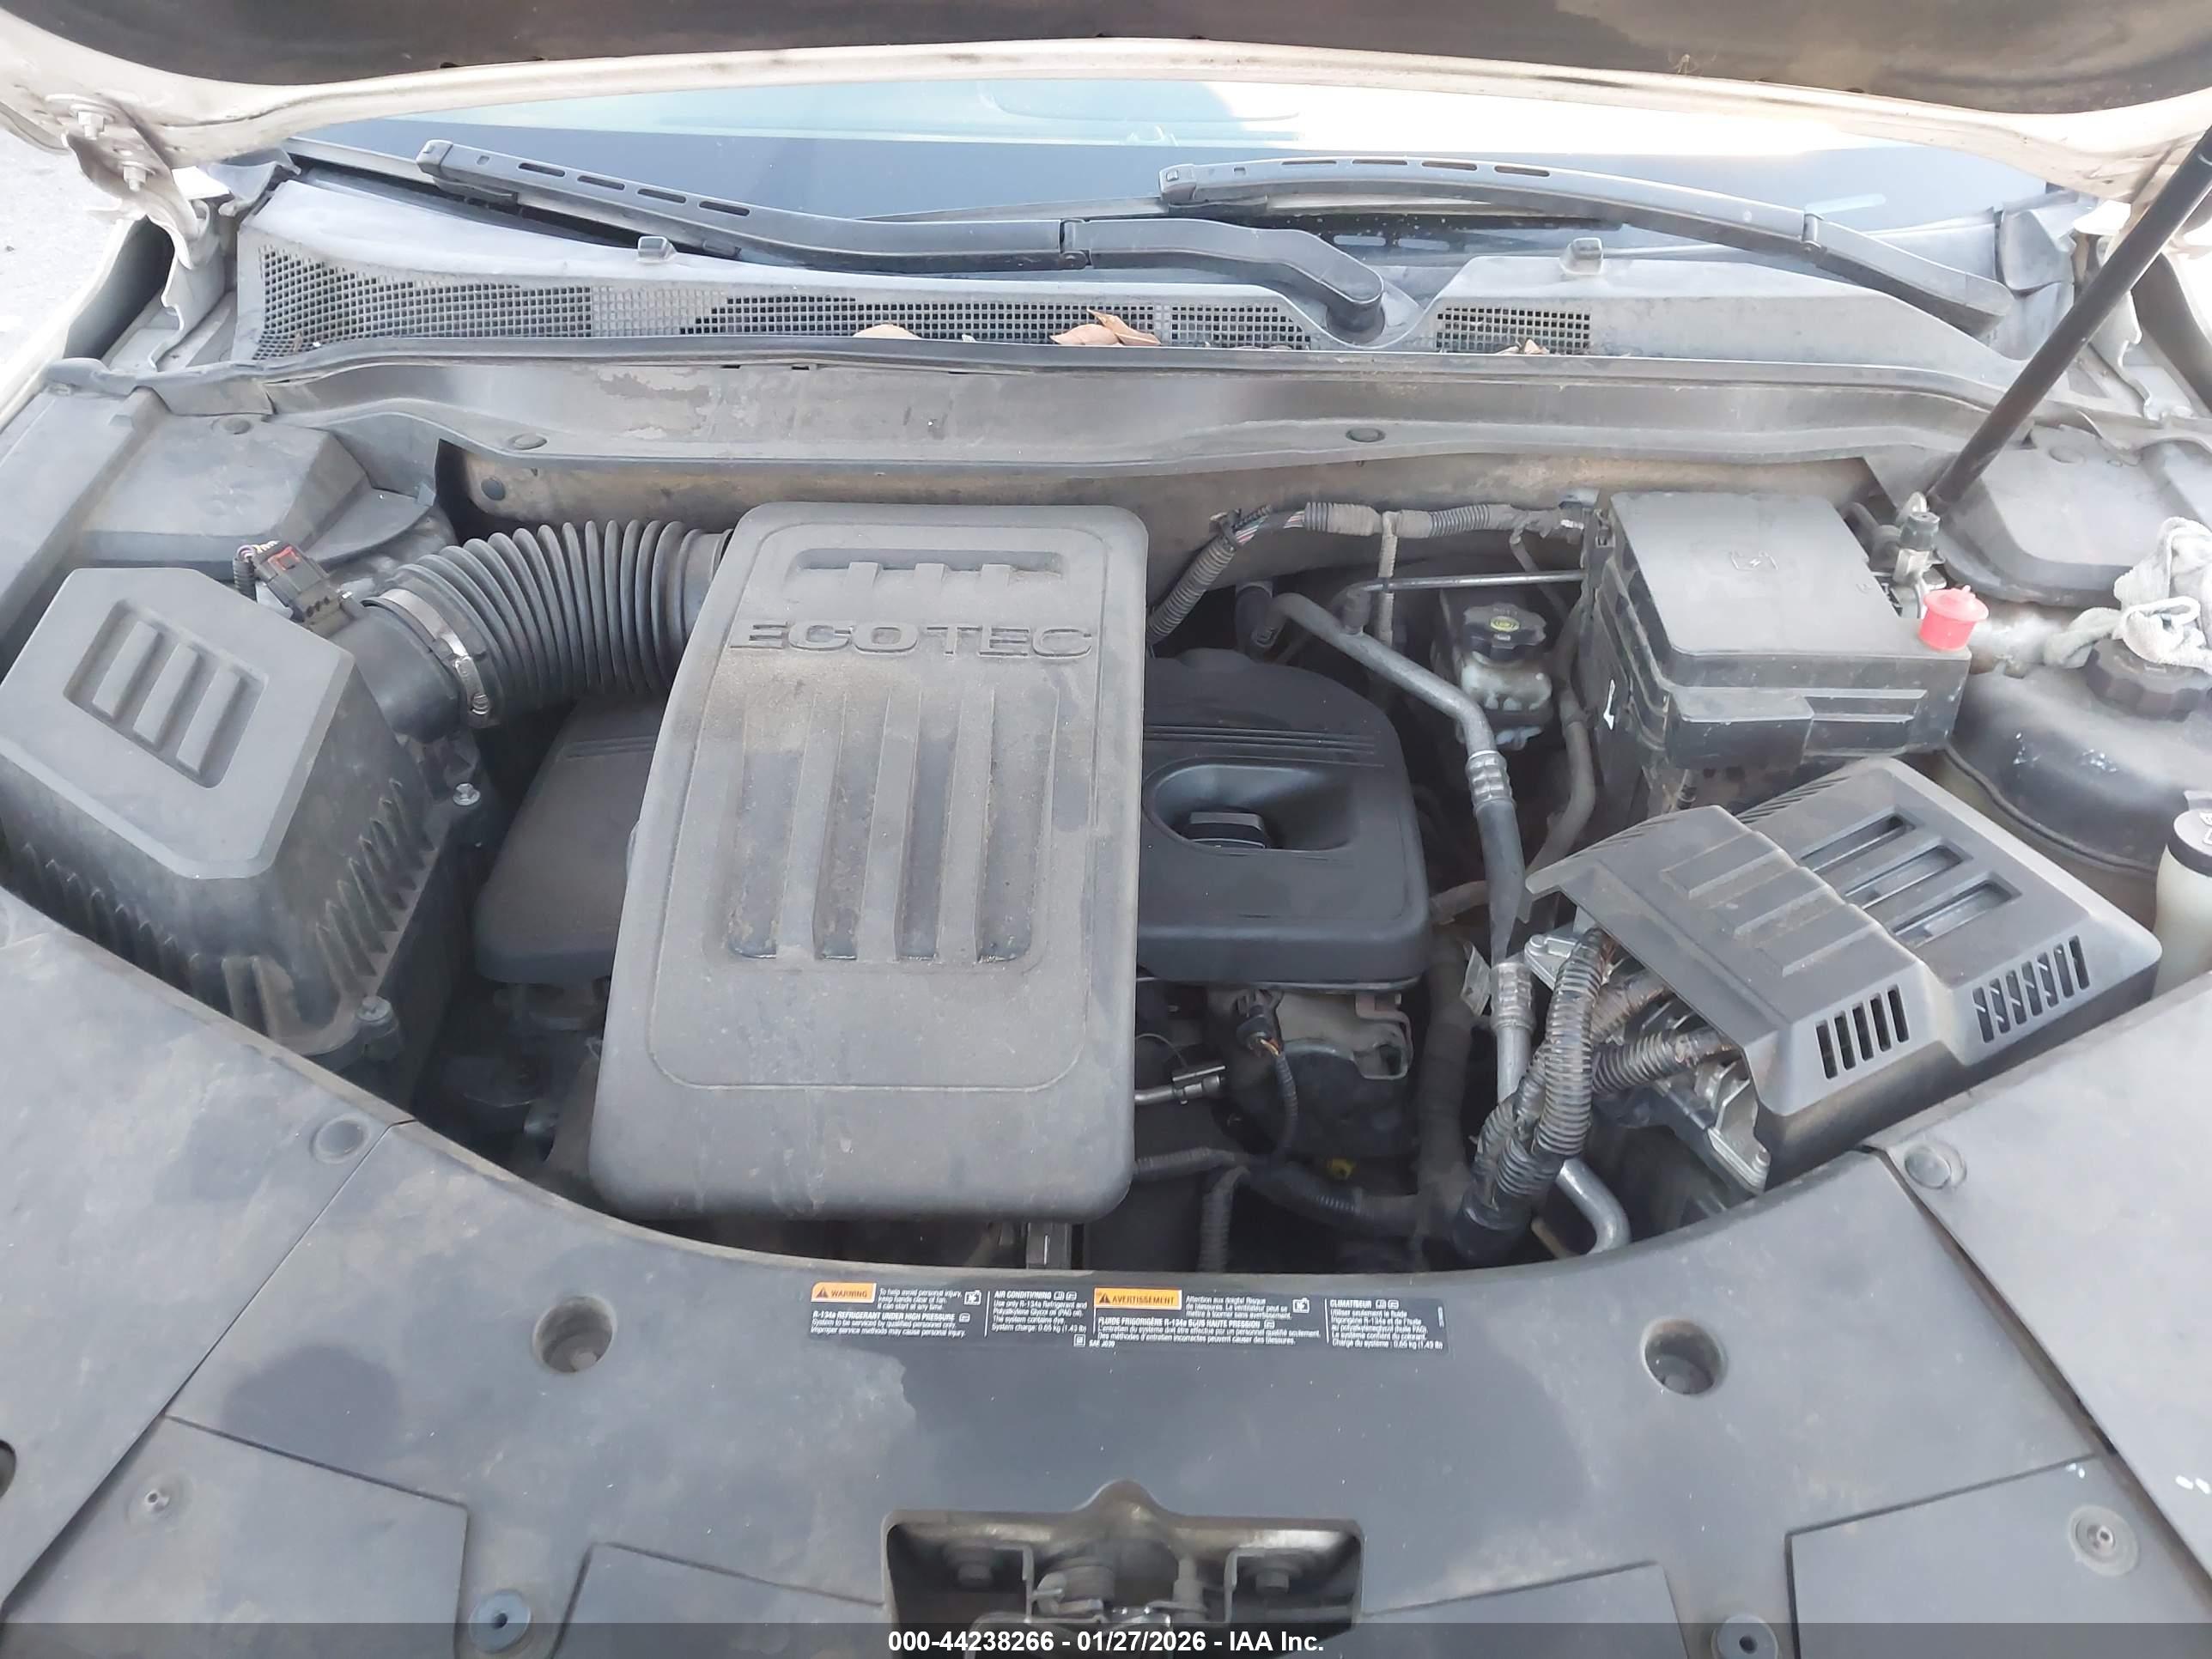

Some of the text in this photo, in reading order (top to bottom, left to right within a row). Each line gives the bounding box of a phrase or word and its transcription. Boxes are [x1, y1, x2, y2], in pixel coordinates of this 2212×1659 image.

[730, 620, 1093, 659] ECOTEC
[887, 1288, 900, 1297] help
[918, 1289, 944, 1297] personal
[1006, 1291, 1052, 1299] CONDITIONING
[1112, 1295, 1175, 1304] AVERTISSEMENT
[1330, 1299, 1372, 1308] CLIMATISEUR
[1006, 1300, 1019, 1309] only
[836, 1310, 881, 1319] REFRIGERANT
[905, 1312, 921, 1321] HIGH
[1098, 1316, 1120, 1325] FLUIDE
[1206, 1319, 1228, 1328] HAUTE
[1228, 1320, 1261, 1328] PRESSION
[991, 1323, 1014, 1332] System
[1332, 1339, 1353, 1348] Charge
[1408, 1340, 1417, 1350] kg
